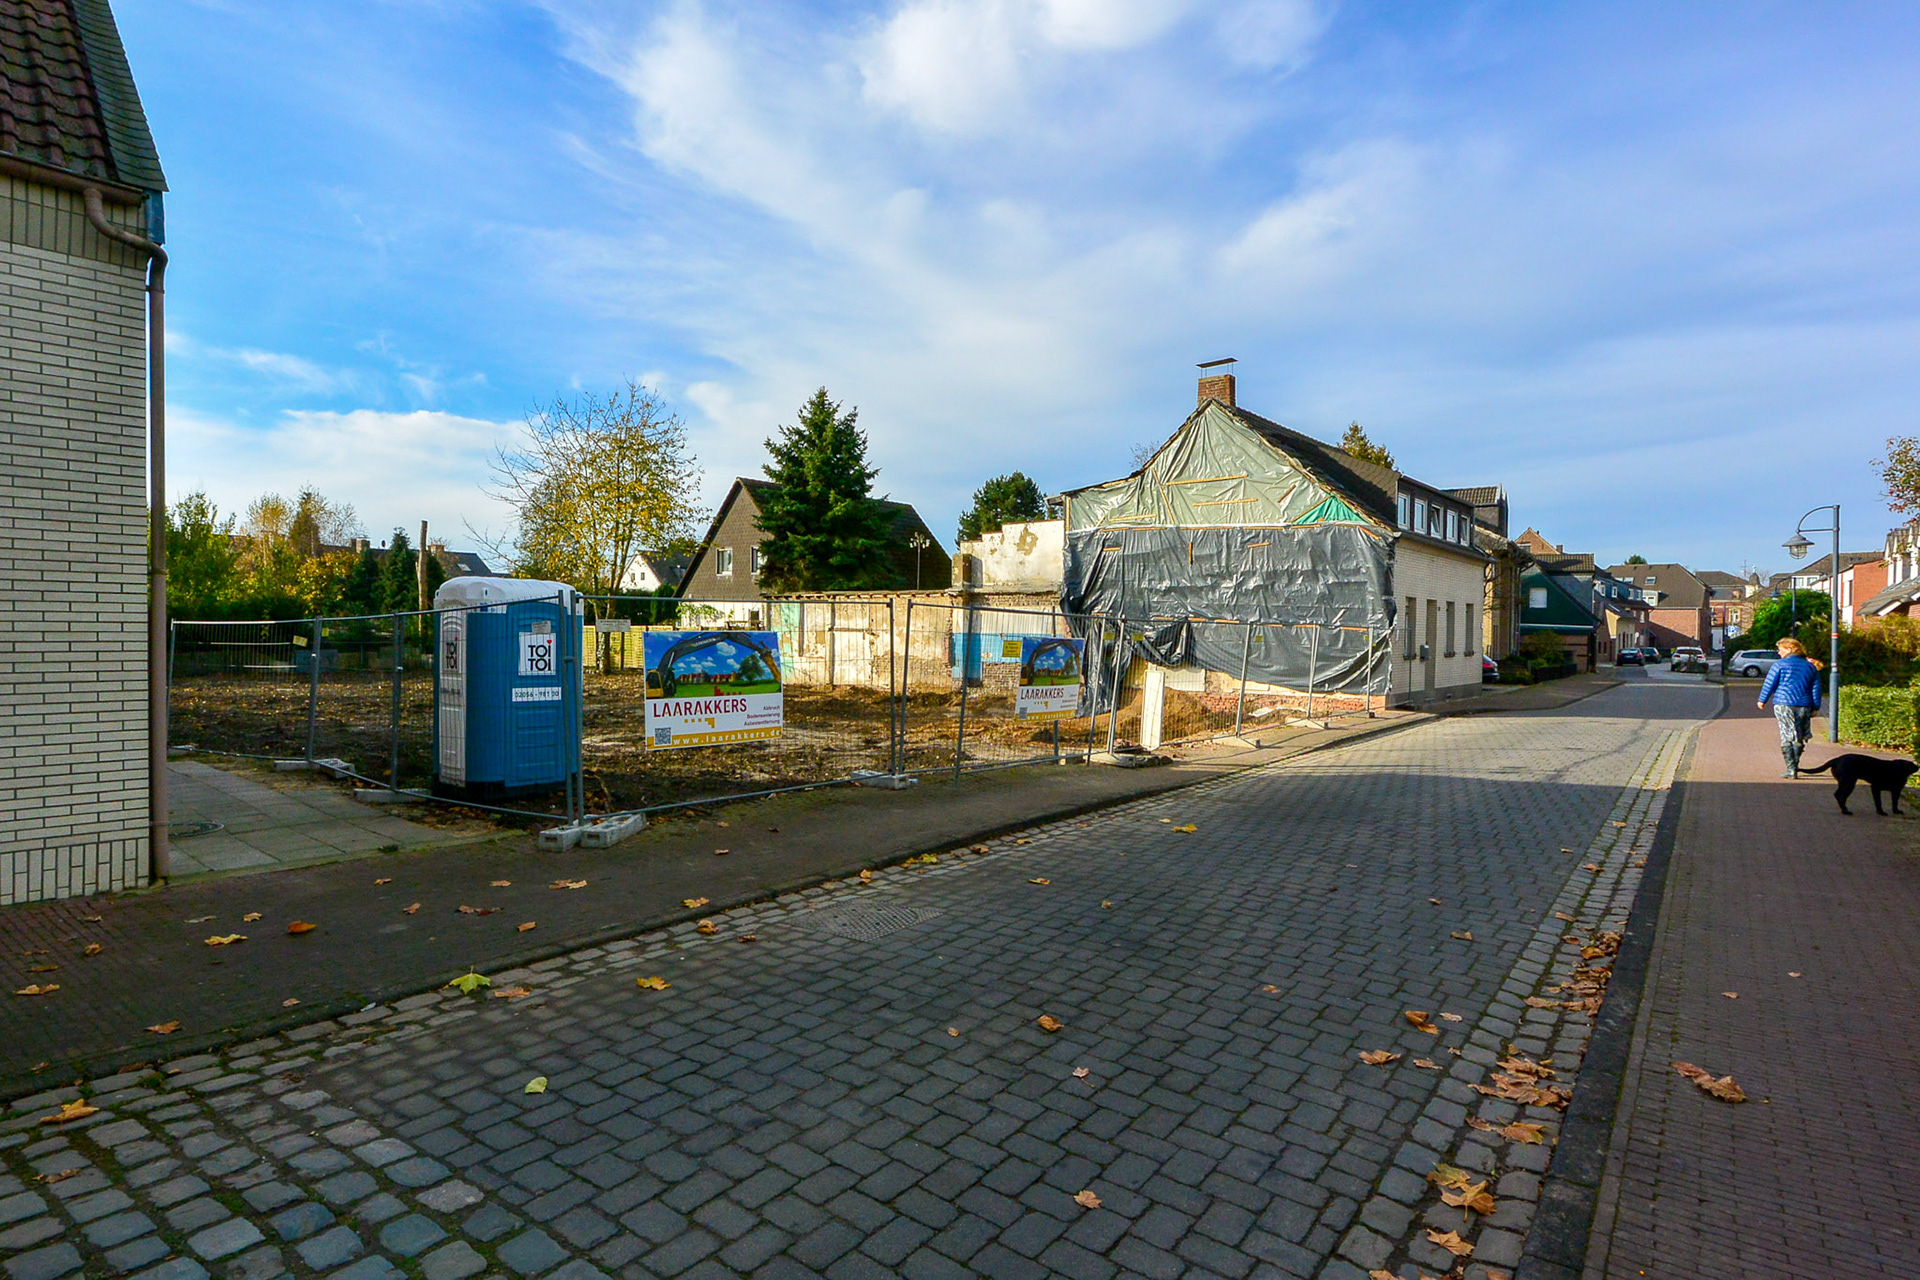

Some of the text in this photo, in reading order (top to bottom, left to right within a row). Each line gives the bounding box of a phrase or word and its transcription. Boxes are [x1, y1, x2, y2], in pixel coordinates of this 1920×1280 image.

[528, 658, 551, 671] TOI
[1021, 688, 1064, 699] LAARAKKERS
[653, 698, 747, 717] LAARAKKERS
[673, 729, 781, 745] www.laarakkers.de
